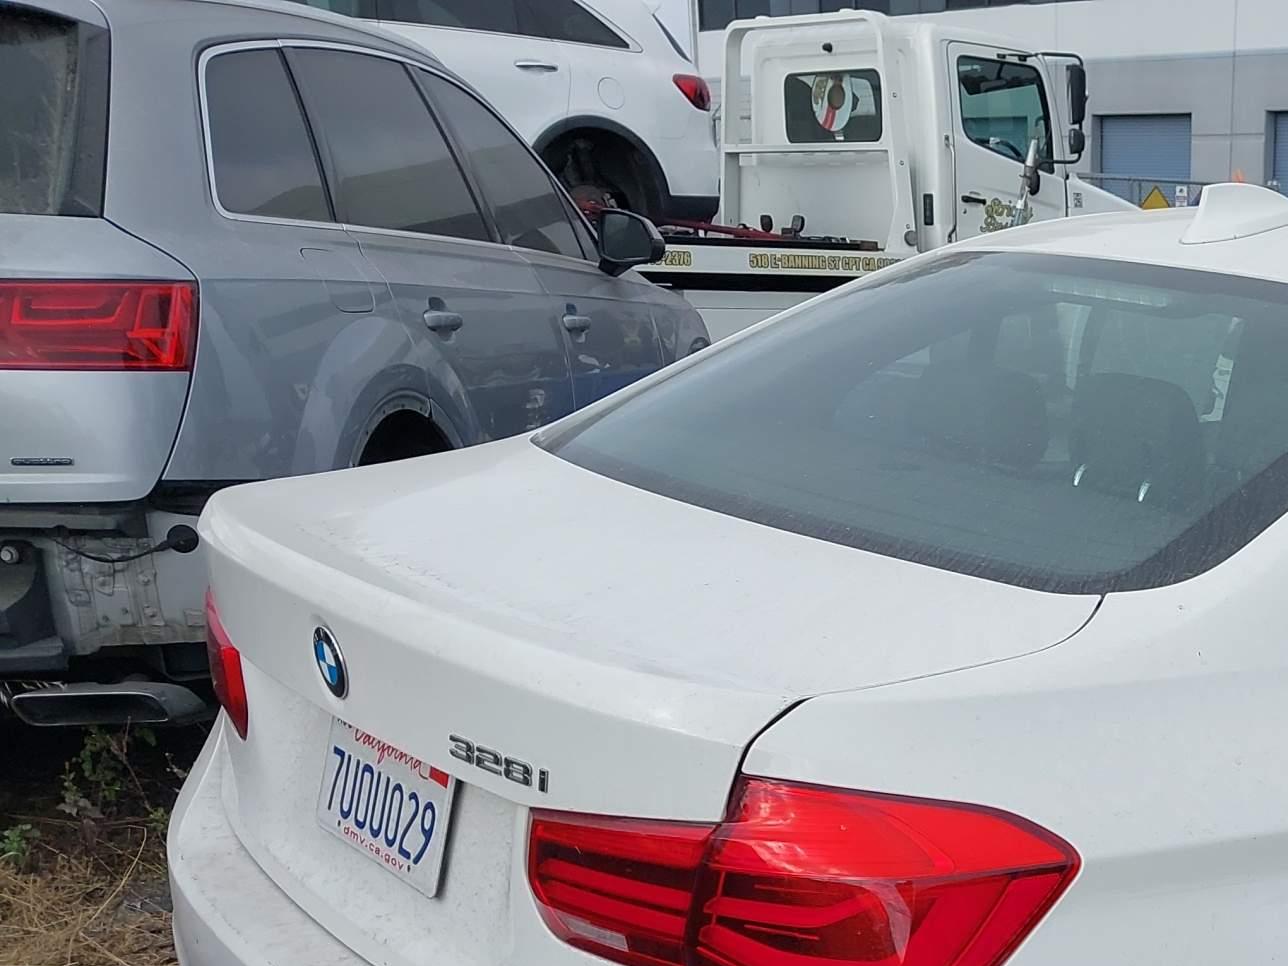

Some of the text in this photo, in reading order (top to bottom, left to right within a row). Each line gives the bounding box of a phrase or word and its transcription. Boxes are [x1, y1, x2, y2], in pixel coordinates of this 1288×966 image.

[749, 253, 769, 269] 518
[828, 256, 841, 270] ST
[841, 256, 862, 271] CPT
[862, 257, 877, 271] CA
[449, 734, 548, 794] 328i
[343, 825, 405, 871] dmv.ca.gov
